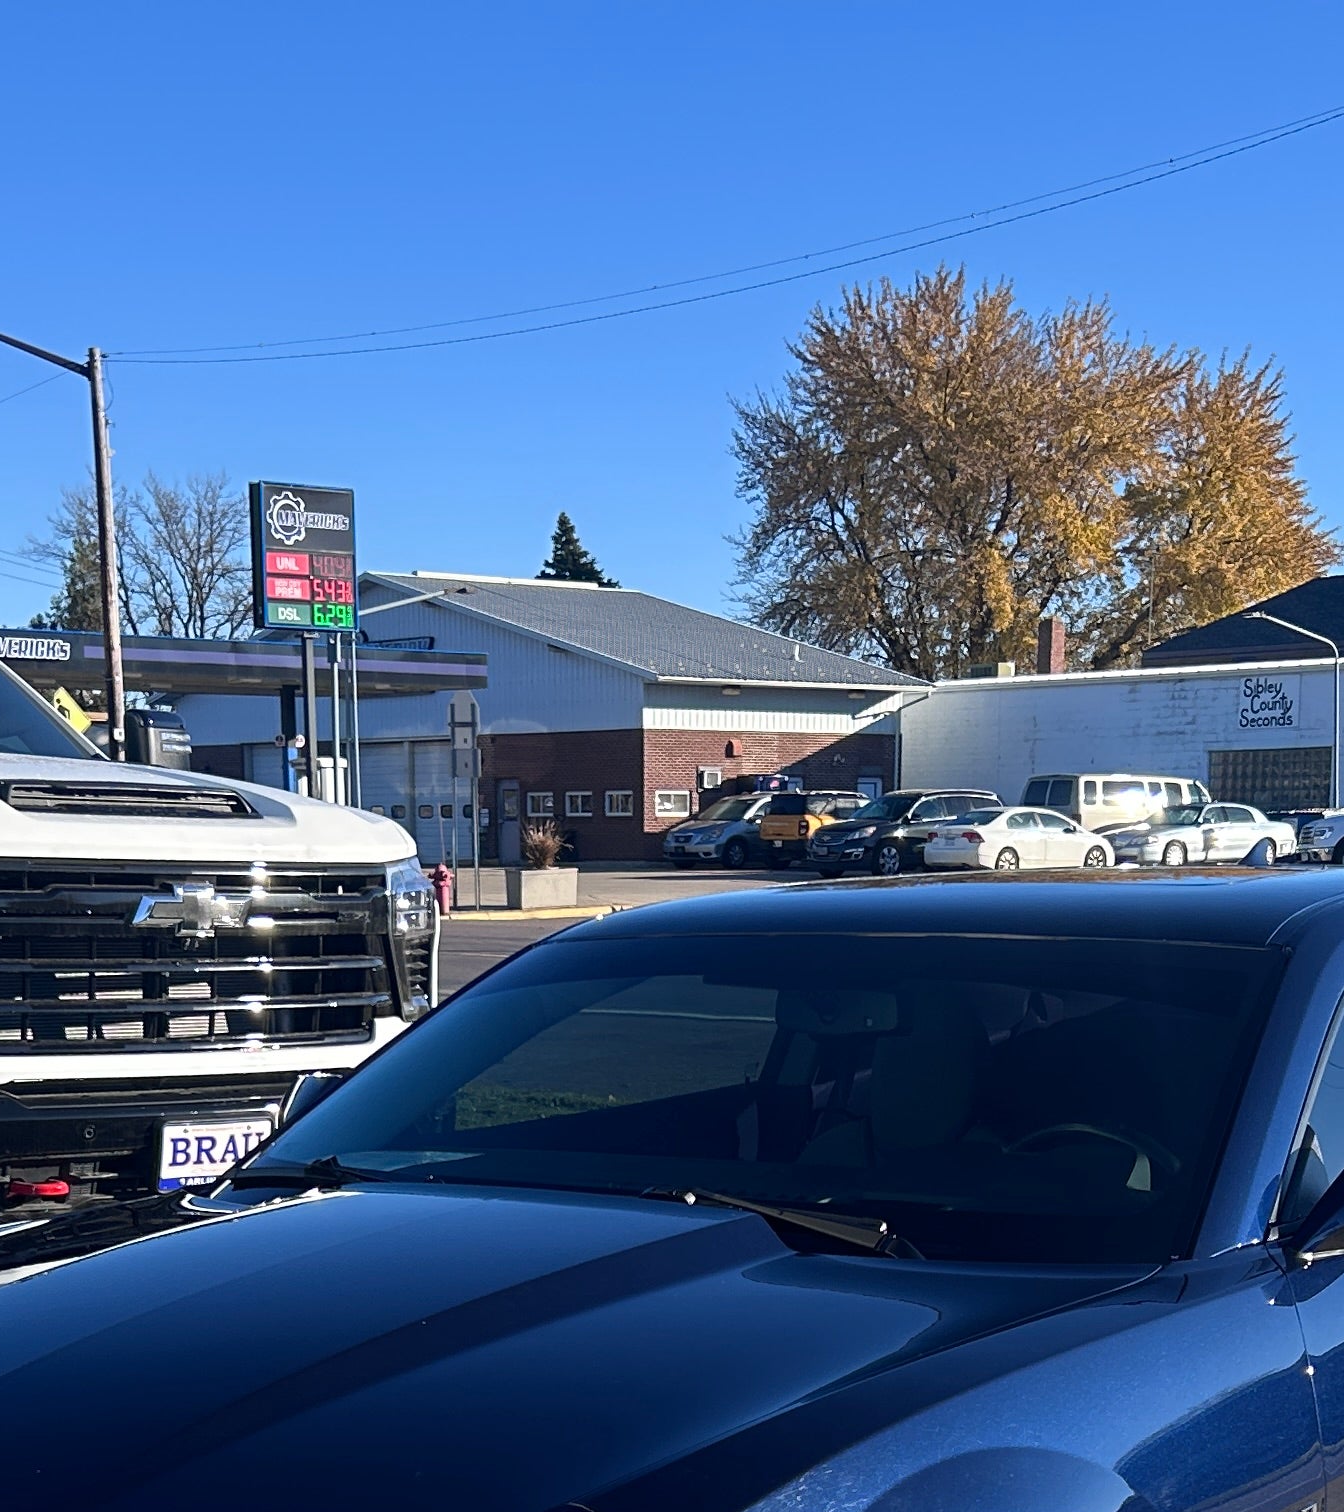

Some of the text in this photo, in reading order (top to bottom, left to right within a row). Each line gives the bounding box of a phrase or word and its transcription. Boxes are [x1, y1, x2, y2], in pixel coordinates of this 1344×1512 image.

[275, 556, 300, 571] UNL
[277, 607, 301, 621] DSL
[1243, 677, 1283, 700] Sibley
[1250, 692, 1293, 716] County
[1239, 708, 1293, 728] Seconds
